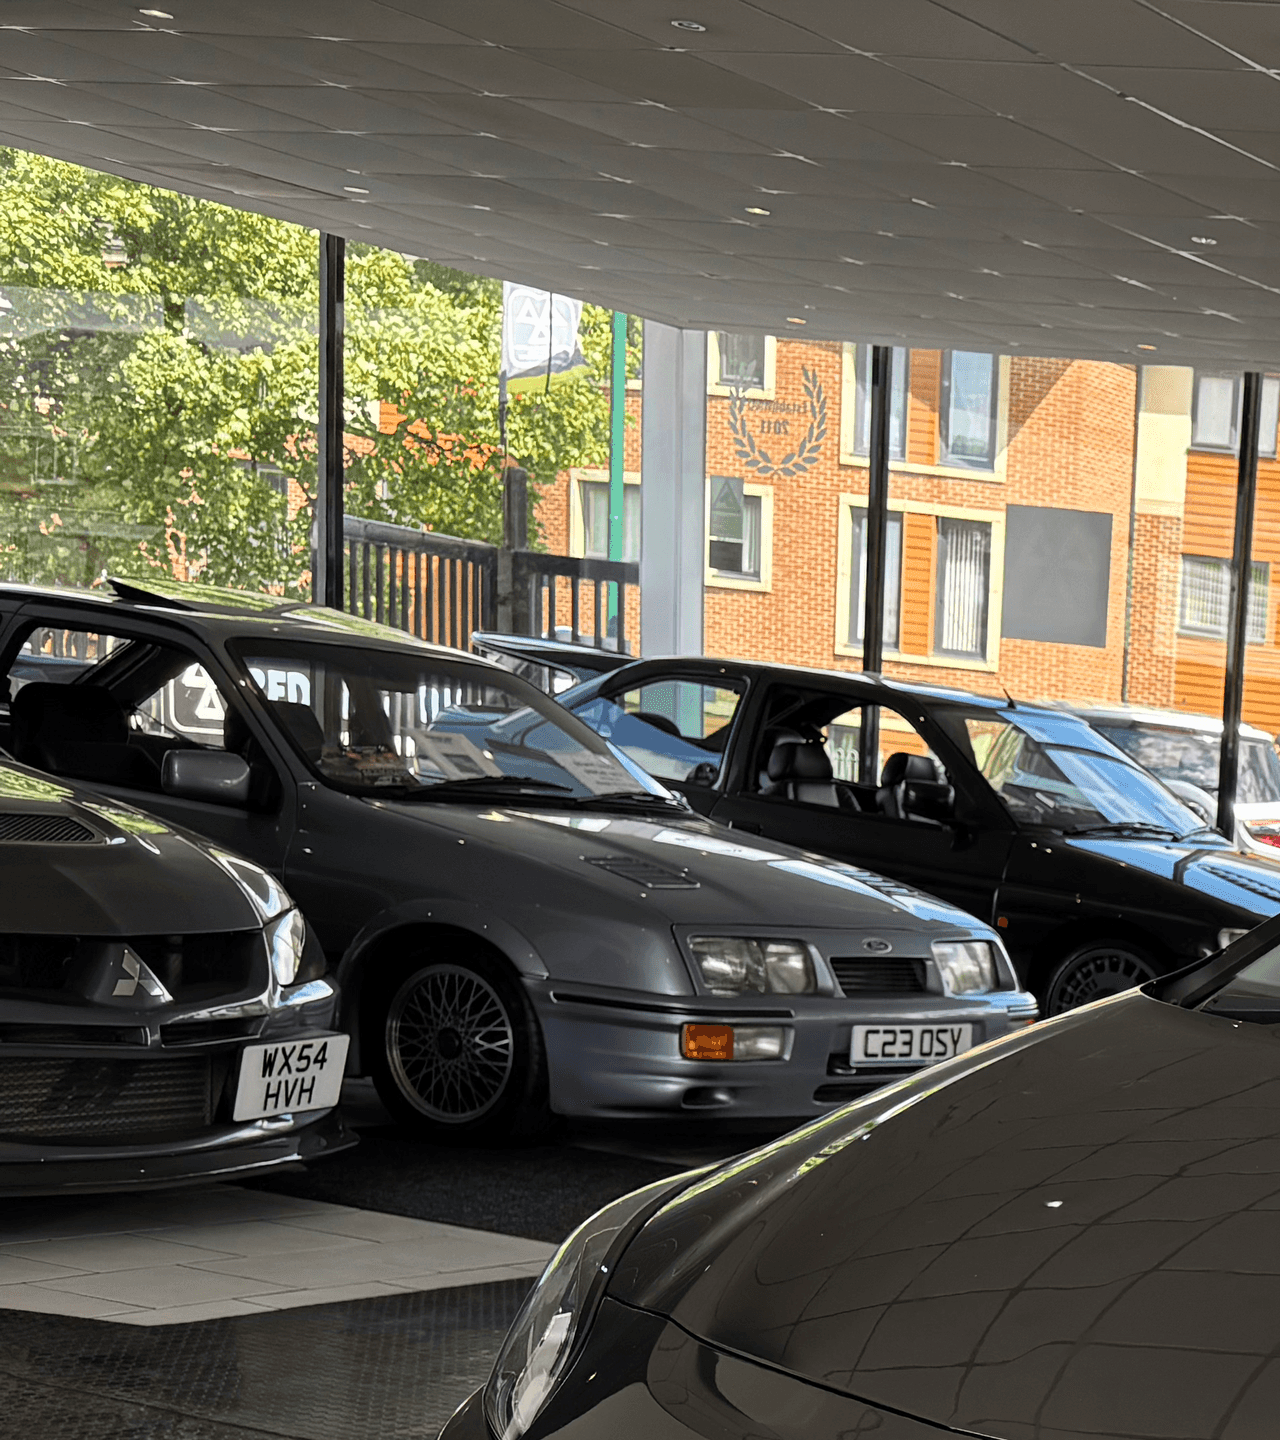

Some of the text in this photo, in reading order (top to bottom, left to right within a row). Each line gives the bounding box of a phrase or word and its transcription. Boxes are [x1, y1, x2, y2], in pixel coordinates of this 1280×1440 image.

[261, 1041, 328, 1078] WX54
[864, 1029, 913, 1058] C23
[263, 1075, 316, 1111] HVH
